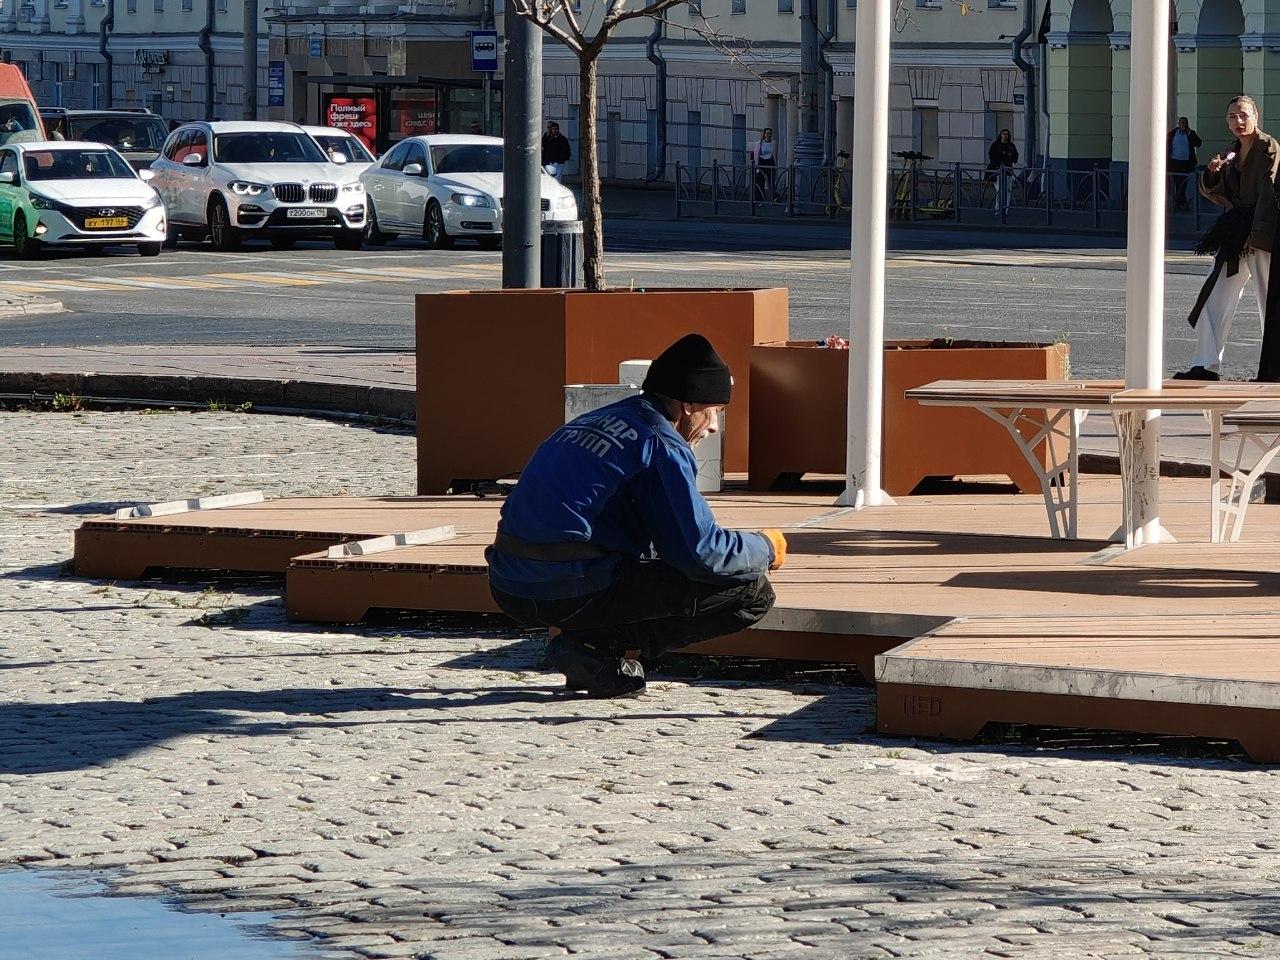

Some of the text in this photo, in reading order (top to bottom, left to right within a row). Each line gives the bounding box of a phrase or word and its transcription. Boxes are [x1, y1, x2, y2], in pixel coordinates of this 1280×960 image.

[330, 103, 366, 113] Полный
[330, 112, 360, 122] фреш
[555, 429, 612, 458] ГРУПП
